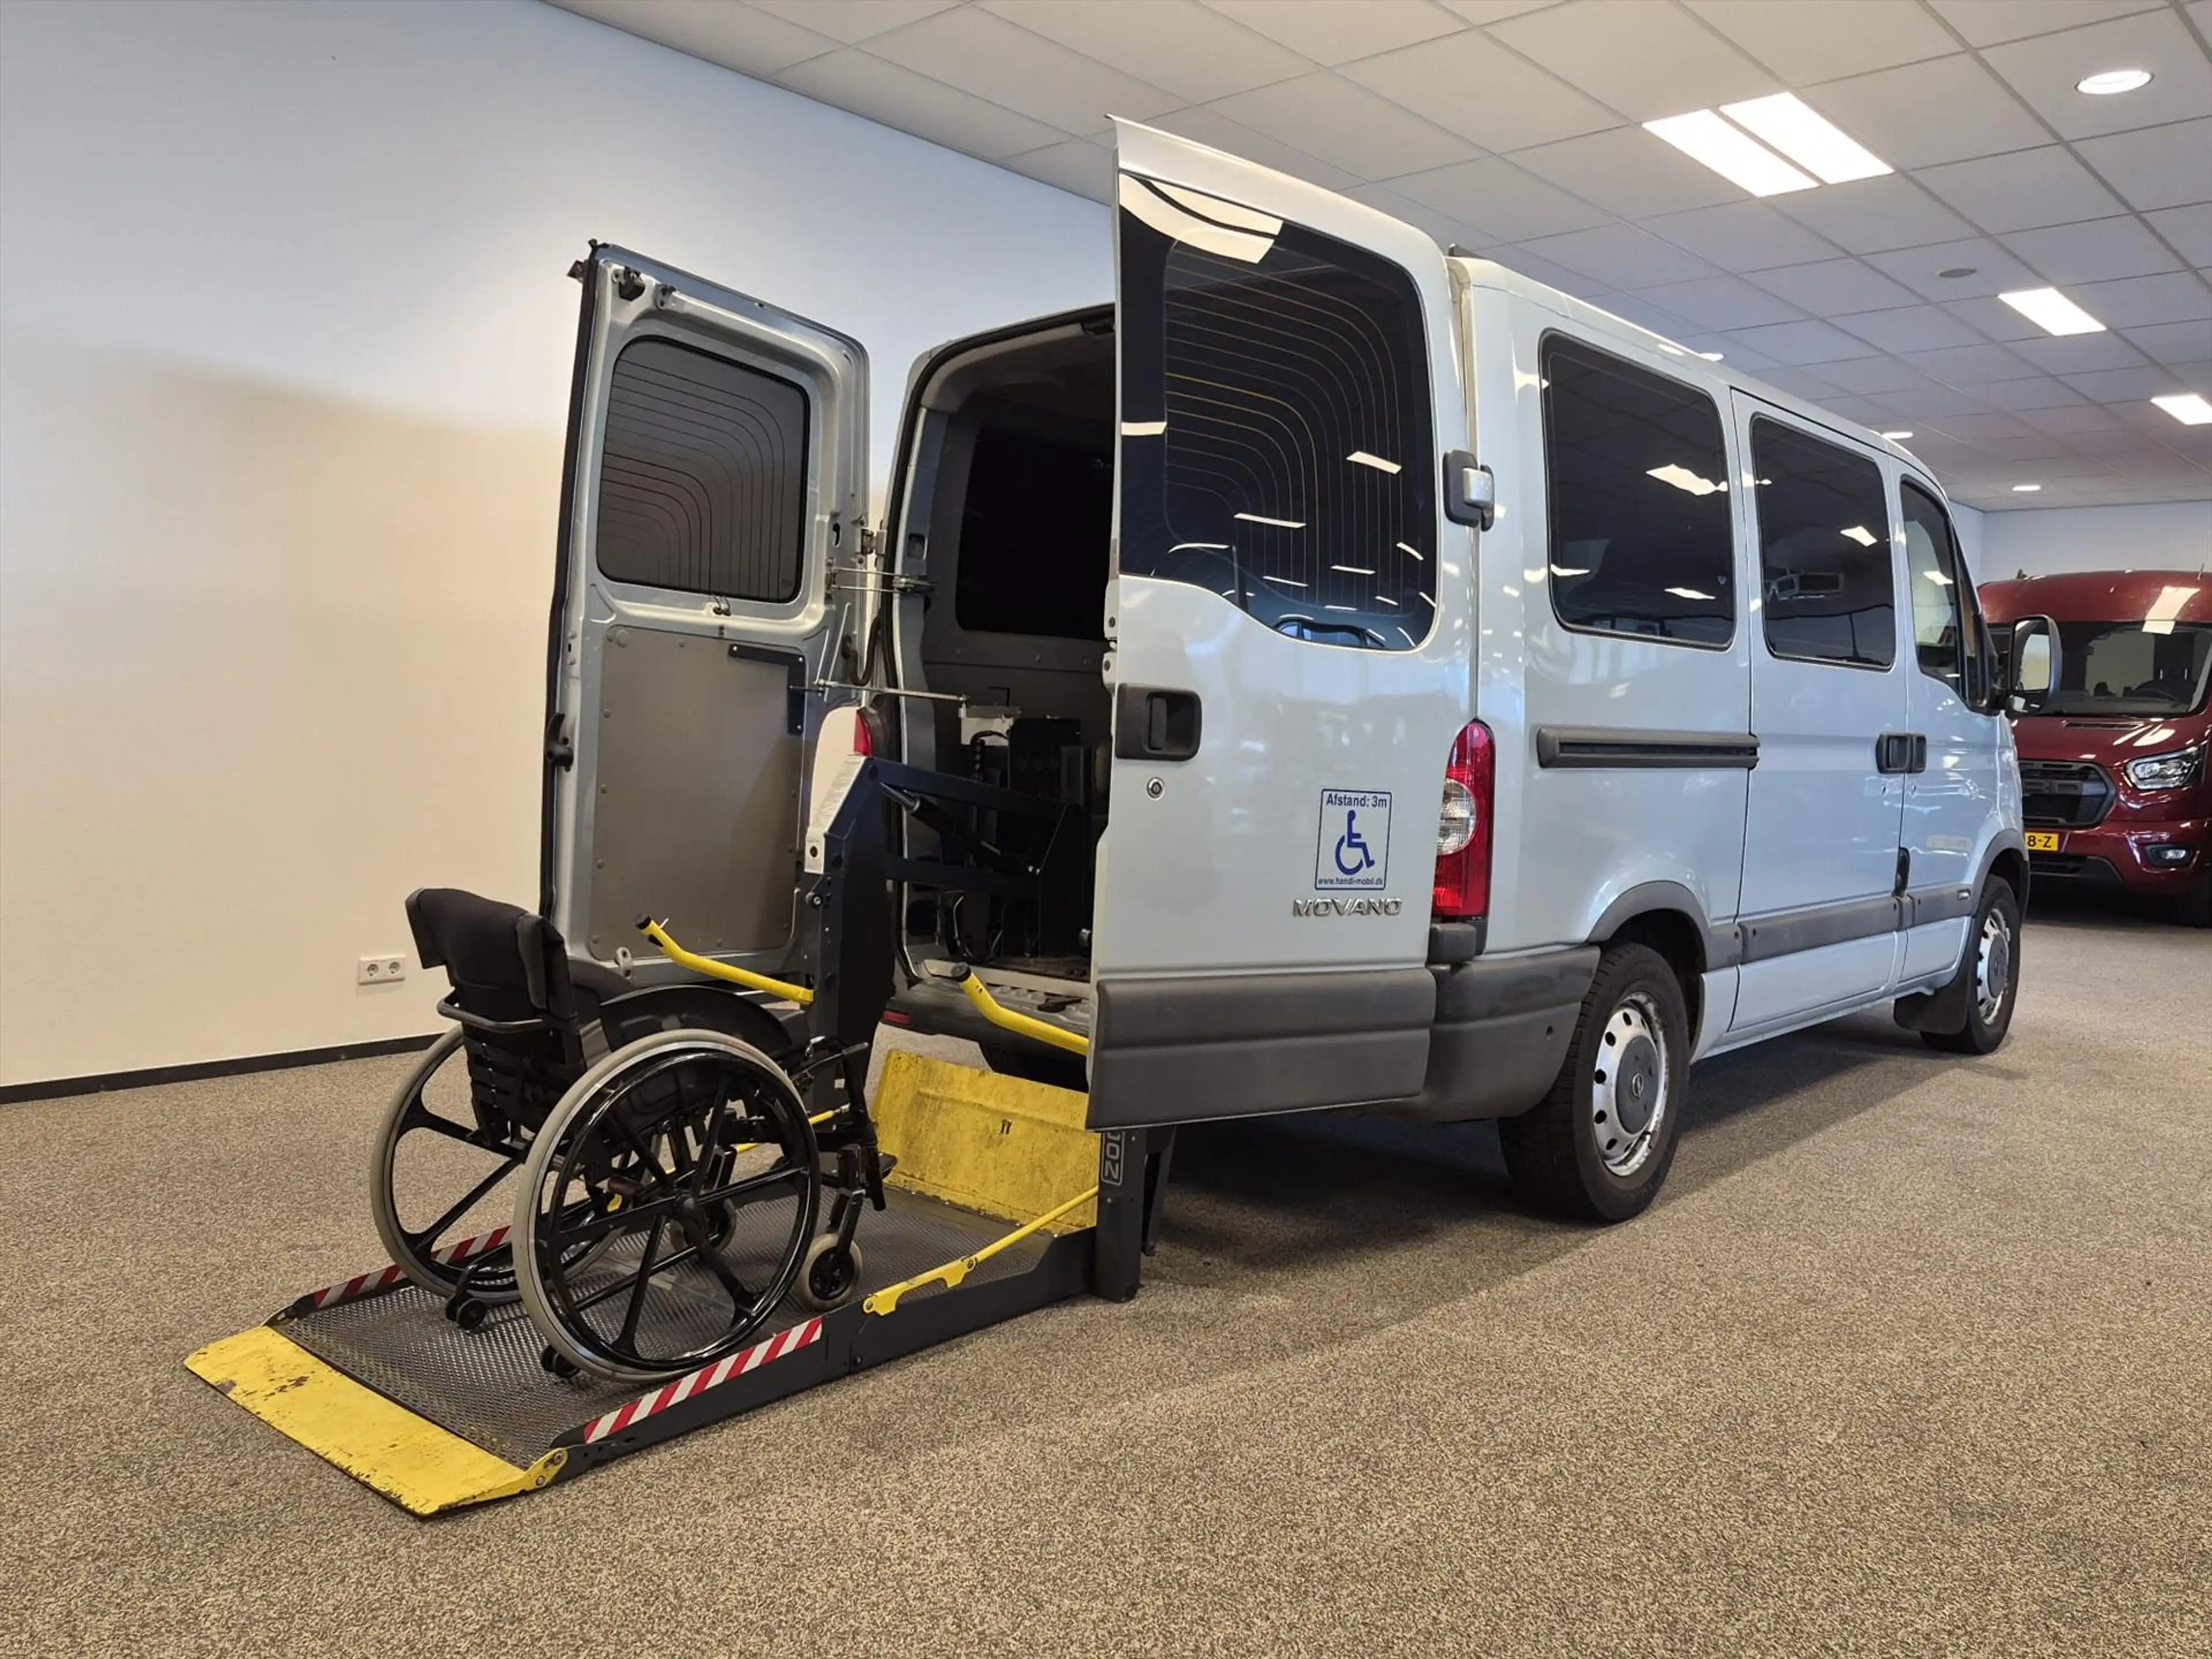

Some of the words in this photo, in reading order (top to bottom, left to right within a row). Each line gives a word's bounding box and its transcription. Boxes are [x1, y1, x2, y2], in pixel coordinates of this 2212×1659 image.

[1326, 793, 1370, 808] Afstand:
[1372, 795, 1387, 808] 3m
[2027, 835, 2052, 849] 8-Z
[1293, 897, 1402, 917] MOVANO
